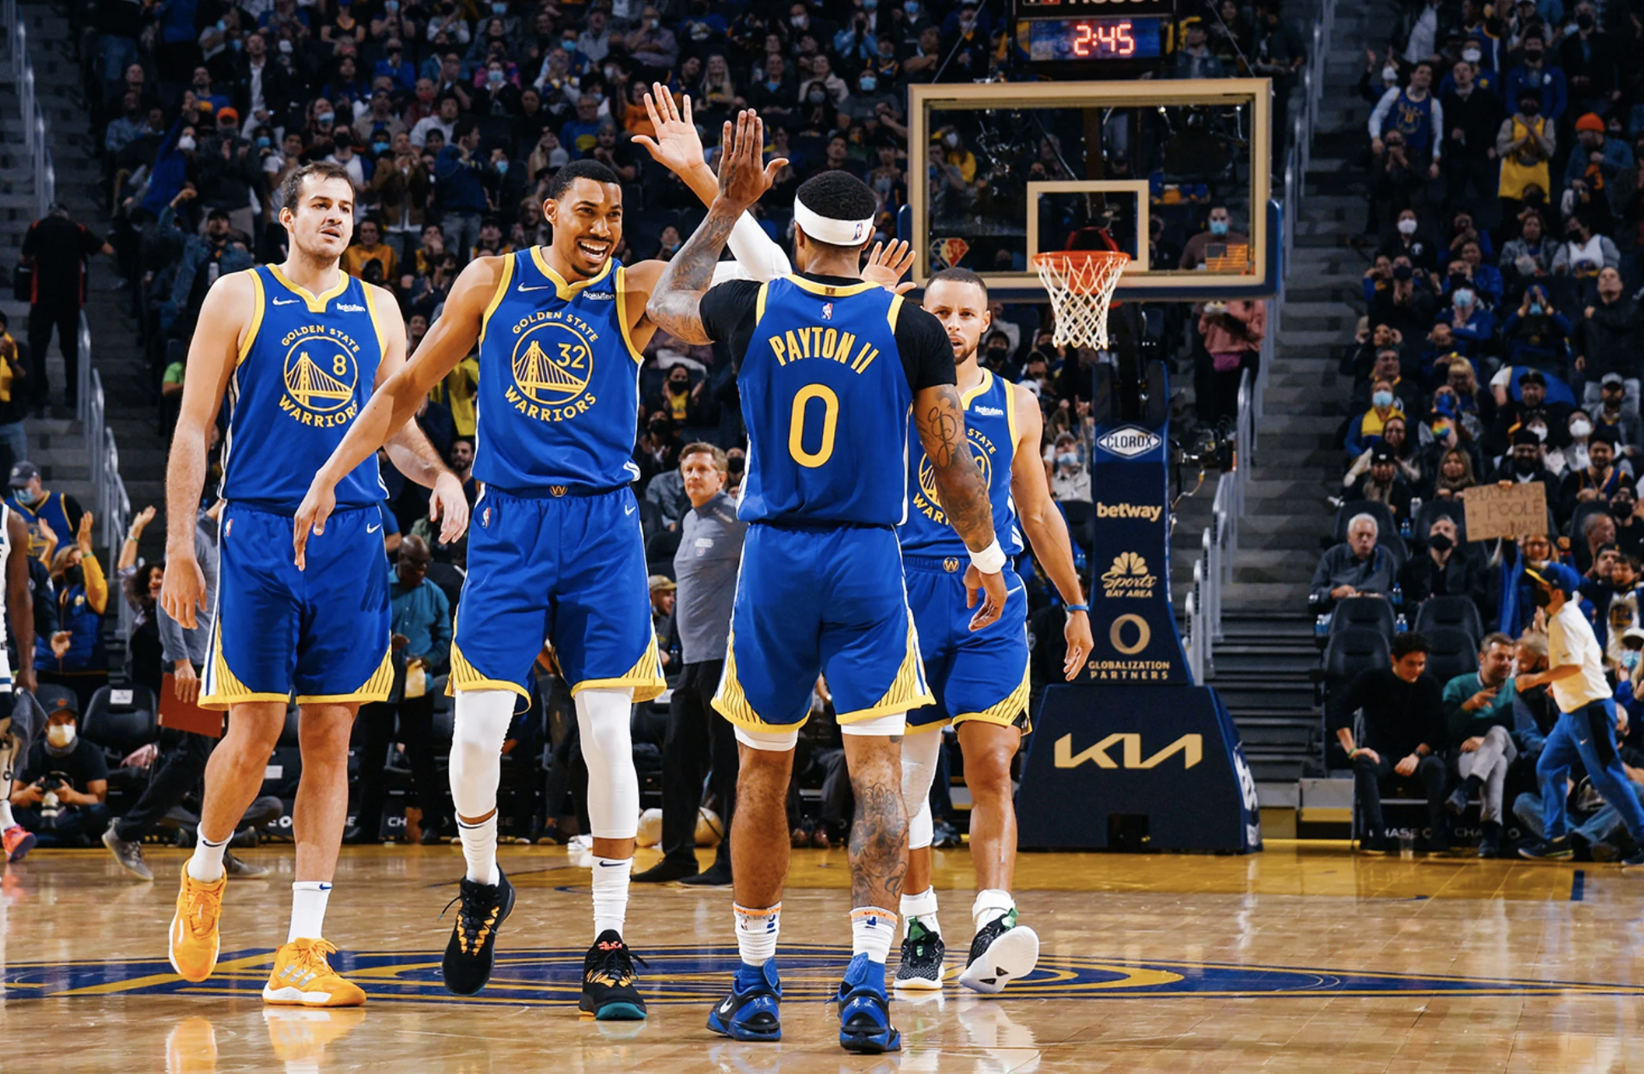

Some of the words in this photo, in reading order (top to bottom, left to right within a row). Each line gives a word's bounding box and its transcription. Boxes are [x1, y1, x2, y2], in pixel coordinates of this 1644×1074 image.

[1074, 23, 1135, 56] 2:45
[581, 290, 615, 301] Rakuten
[512, 311, 562, 334] GOLDEN
[566, 314, 599, 342] STATE
[281, 325, 325, 346] GOLDEN
[329, 328, 360, 353] STATE
[769, 327, 856, 367] PAYTON
[333, 354, 347, 376] 8
[556, 343, 586, 369] 32
[504, 385, 596, 421] WARRIORS
[788, 383, 839, 468] 0
[967, 428, 997, 455] STATE
[1106, 435, 1153, 450] CLOROX
[1097, 502, 1162, 522] betway
[1487, 498, 1543, 520] POOLE
[1101, 572, 1157, 589] Sports
[1105, 589, 1124, 598] BAY
[1126, 589, 1153, 598] AREA
[1088, 661, 1170, 670] GLOBALIZATION
[1090, 671, 1168, 679] PARTNERS
